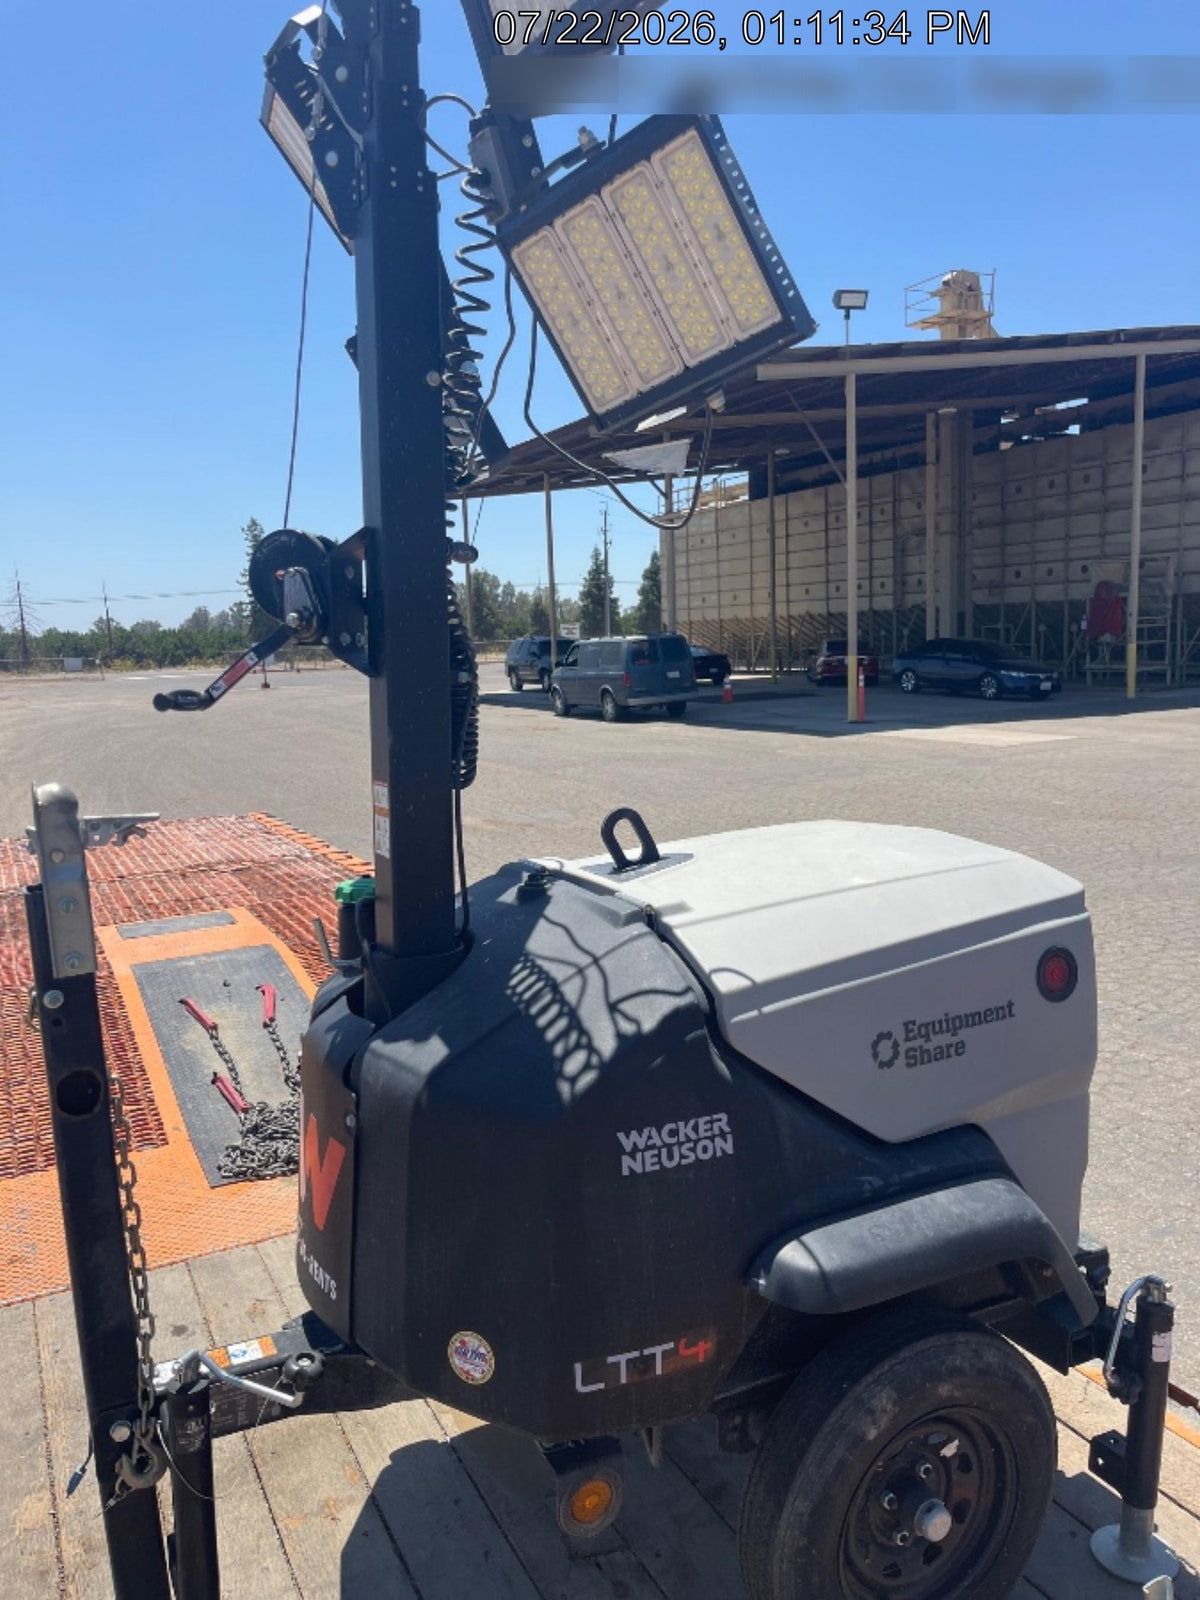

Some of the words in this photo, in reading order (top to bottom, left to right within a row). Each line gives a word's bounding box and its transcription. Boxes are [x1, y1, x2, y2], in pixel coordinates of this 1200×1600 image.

[903, 999, 1015, 1044] Equipment
[904, 1039, 966, 1069] Share
[616, 1112, 731, 1153] WACKER
[621, 1133, 734, 1176] NEUSON
[573, 1338, 713, 1393] LTT4
